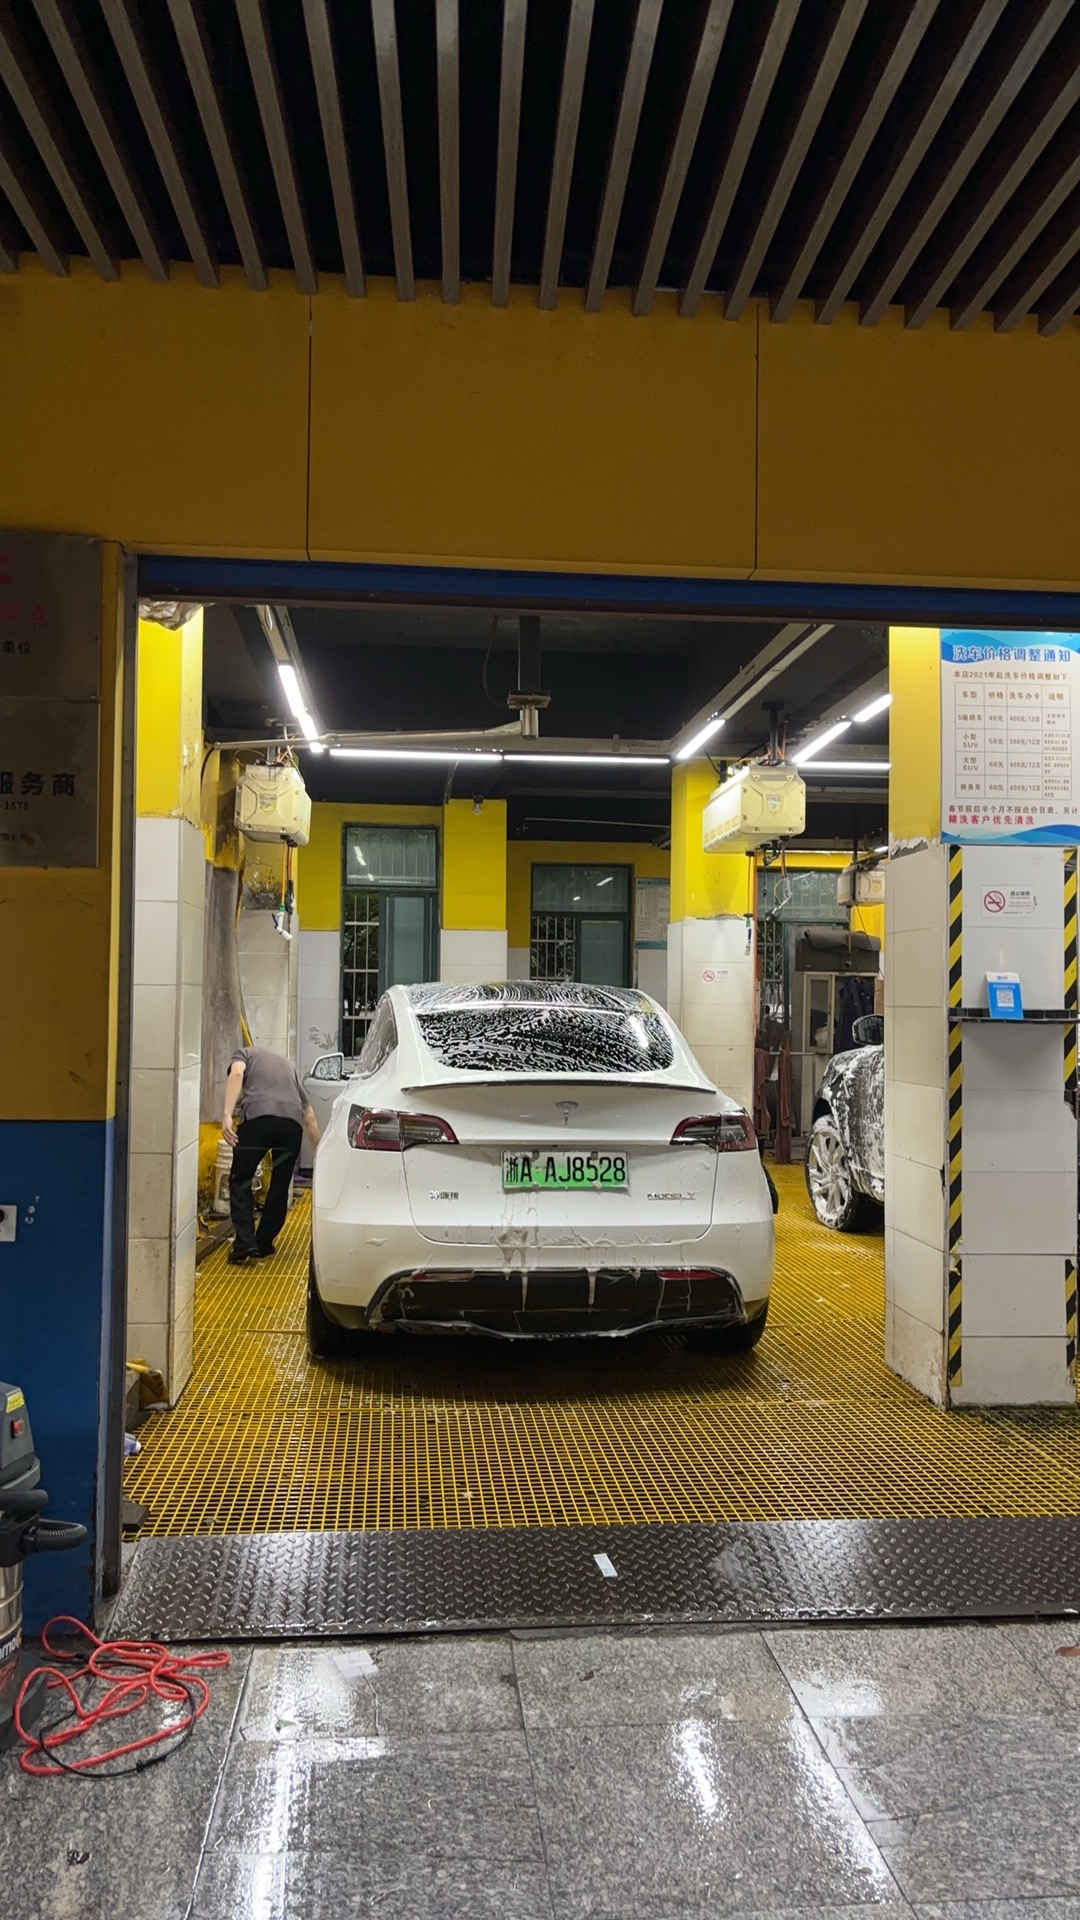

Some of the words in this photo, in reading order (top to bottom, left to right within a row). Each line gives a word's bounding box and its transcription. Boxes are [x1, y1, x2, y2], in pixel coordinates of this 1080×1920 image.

[952, 646, 1071, 662] 洗车价格调整通知
[962, 691, 978, 699] 车型
[988, 691, 1004, 699] 价格
[1009, 692, 1041, 700] 洗车办卡
[1048, 692, 1064, 700] 说明
[948, 815, 1035, 825] 精洗客户优先清洗
